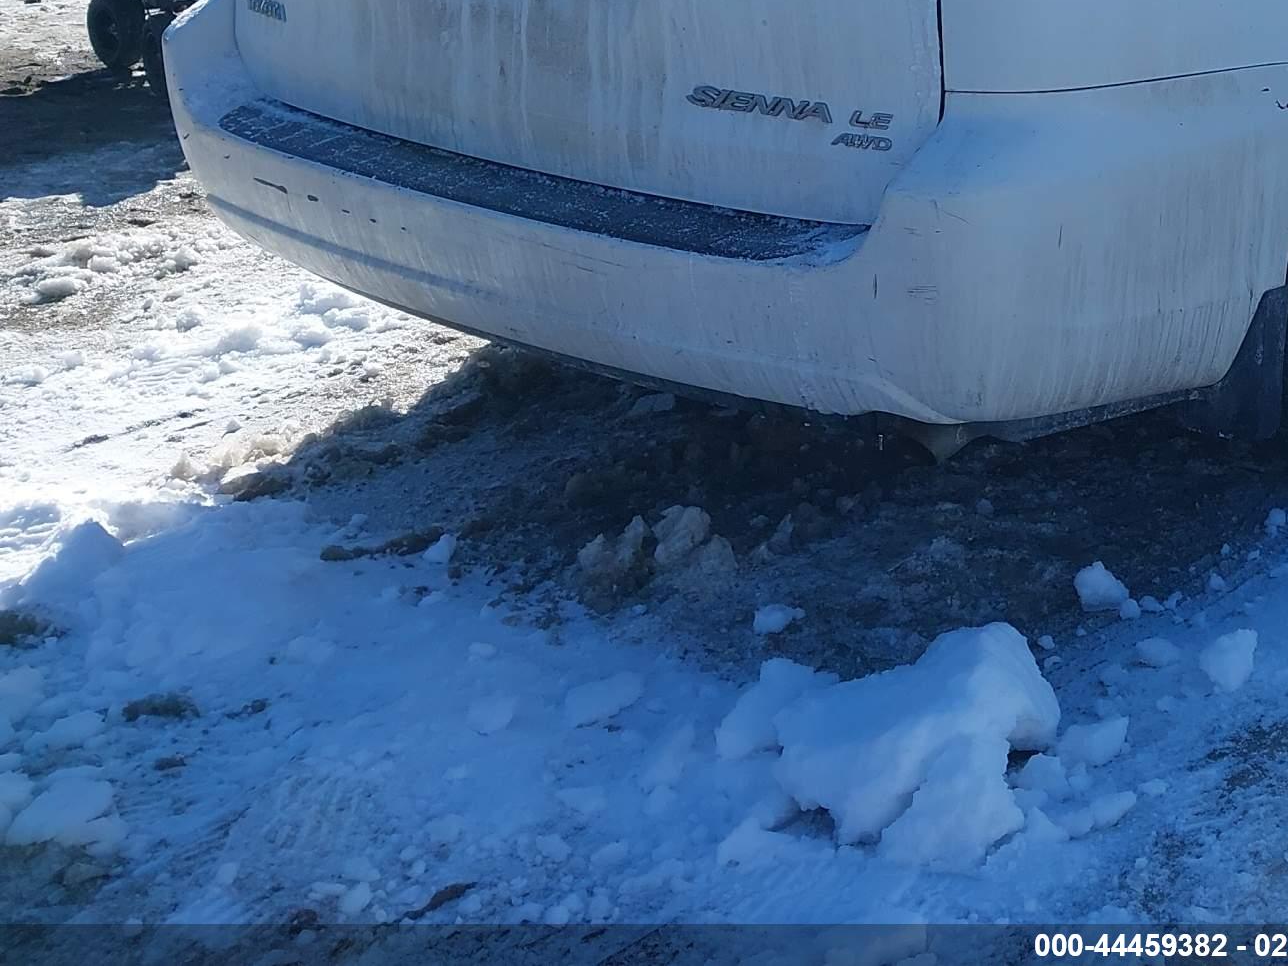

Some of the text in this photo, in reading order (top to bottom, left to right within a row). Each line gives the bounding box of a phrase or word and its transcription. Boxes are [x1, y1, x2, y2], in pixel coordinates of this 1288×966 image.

[685, 85, 894, 130] SIENNA LE
[830, 133, 894, 152] AWD
